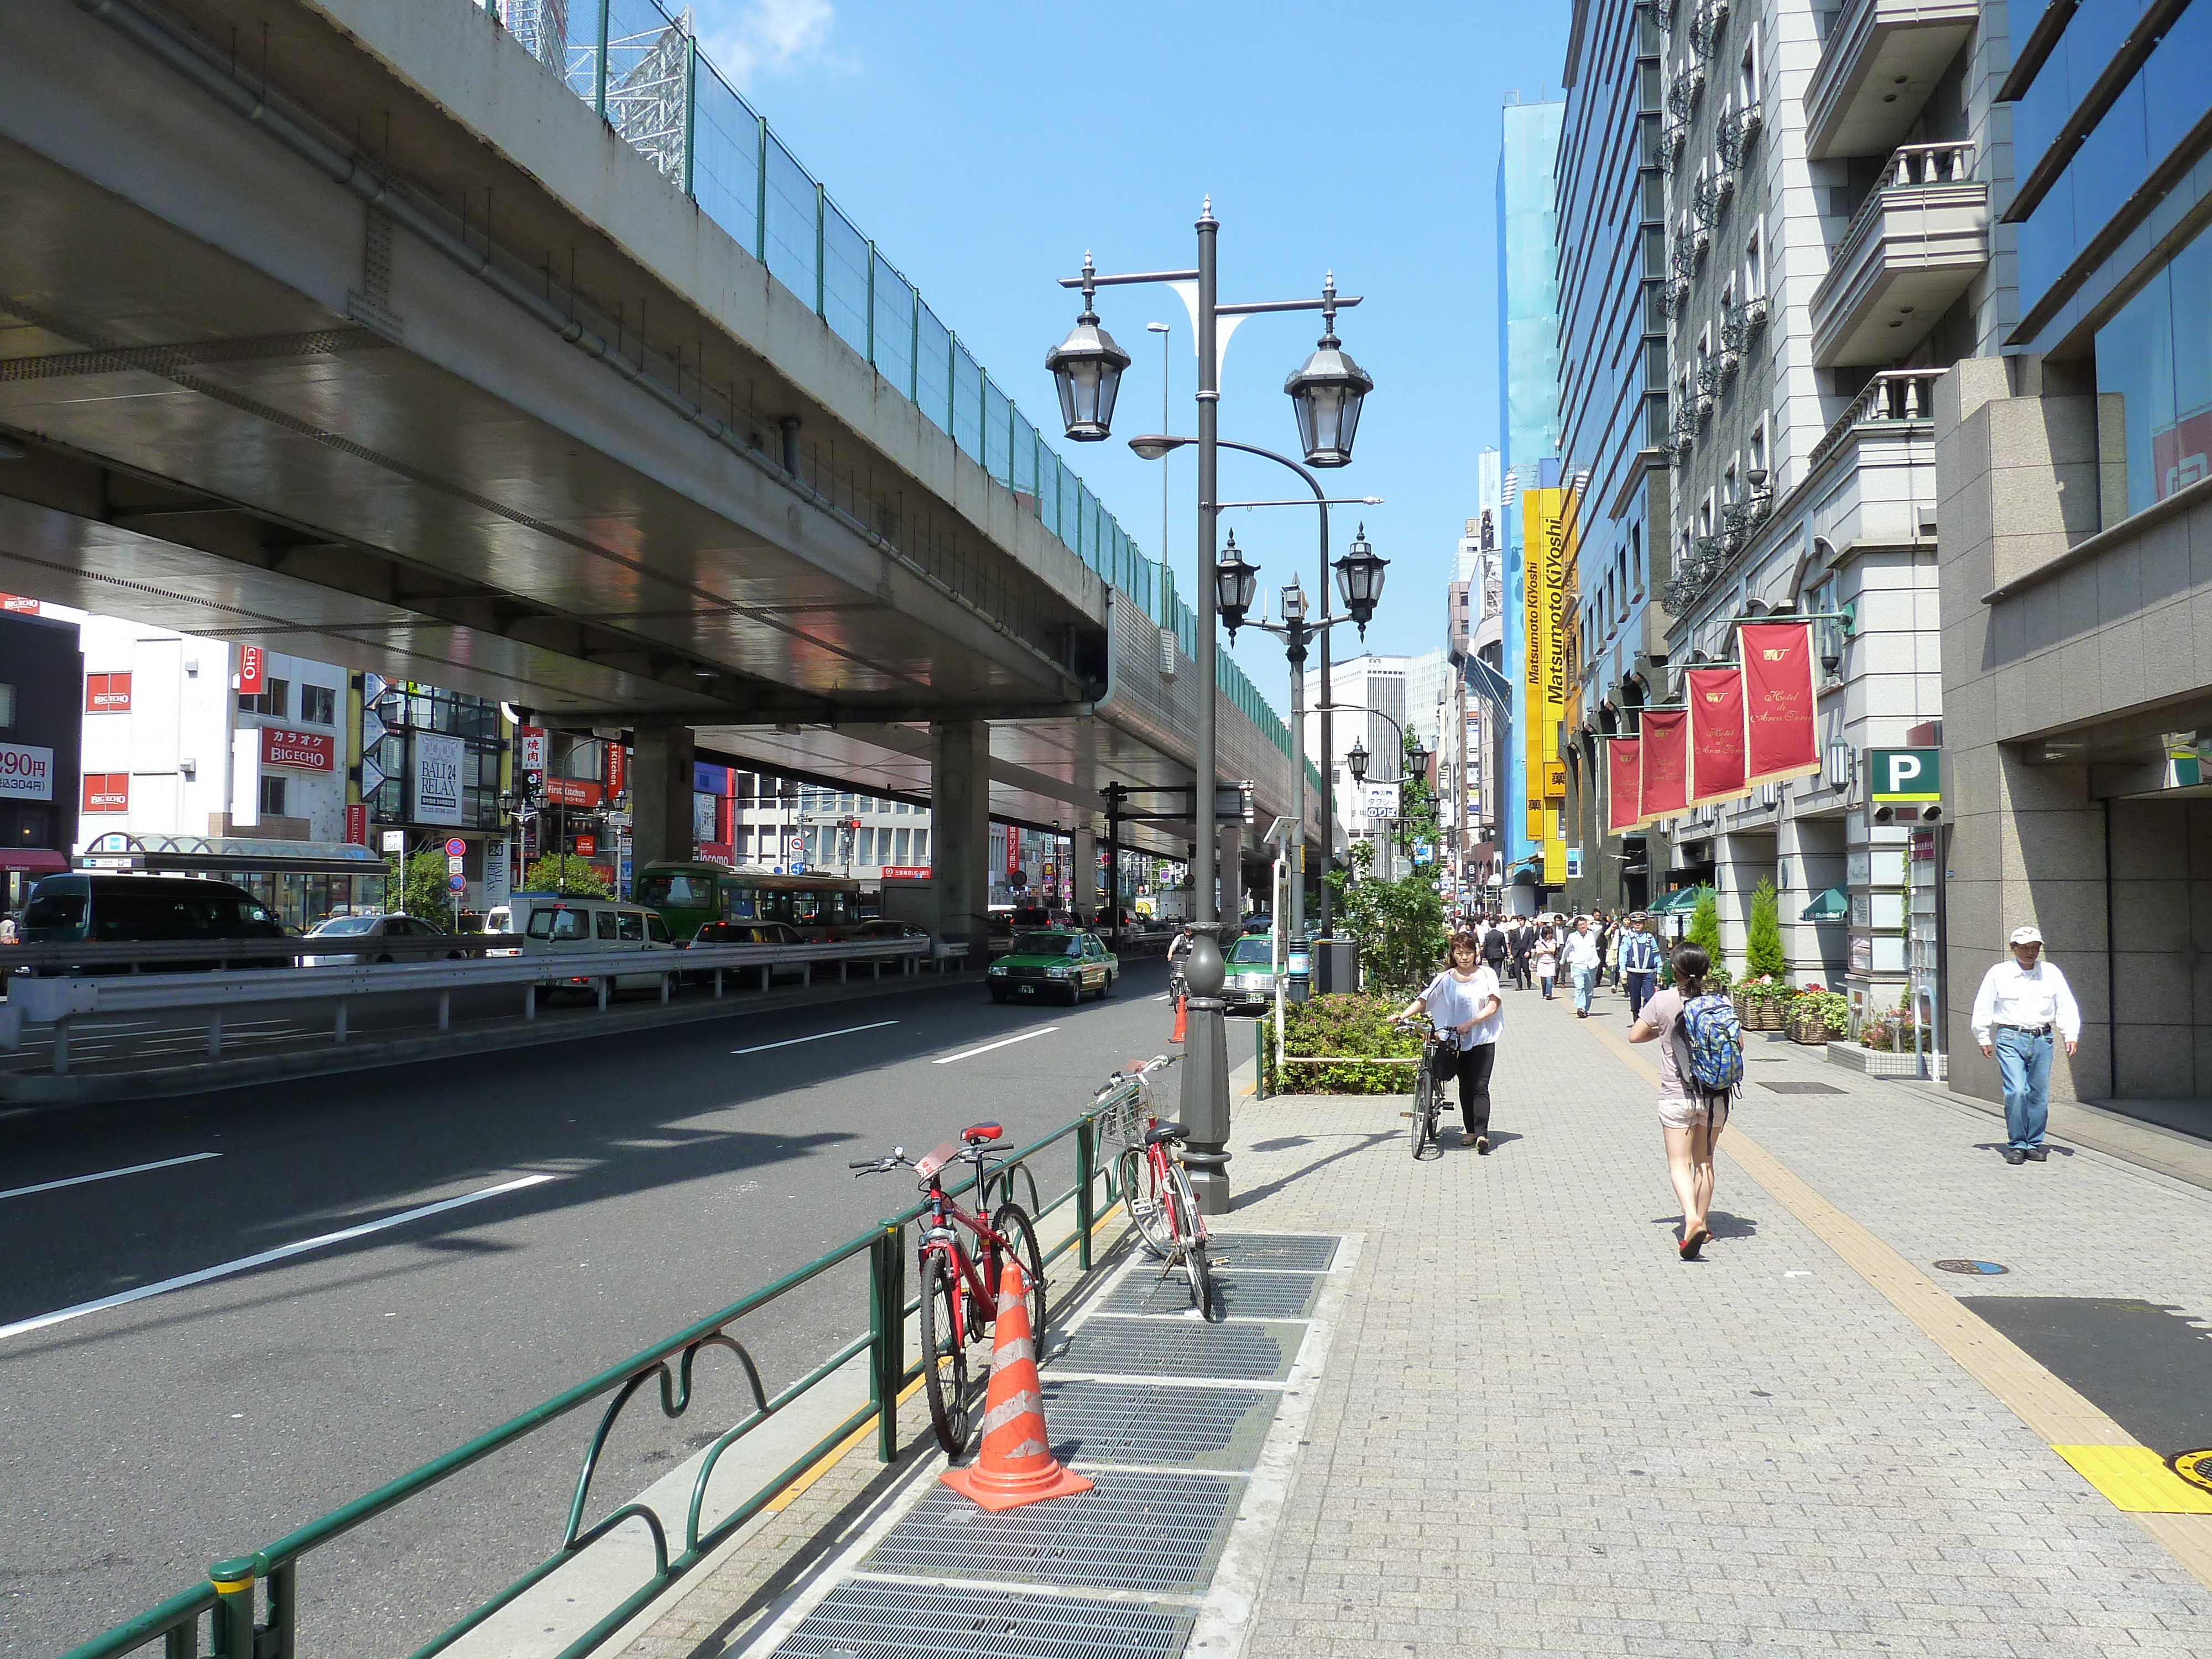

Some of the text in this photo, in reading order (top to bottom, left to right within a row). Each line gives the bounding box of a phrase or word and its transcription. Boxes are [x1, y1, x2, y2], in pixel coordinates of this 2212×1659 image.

[1528, 611, 1539, 685] Matsumoto
[1547, 589, 1563, 705] Matsumoto
[94, 695, 128, 704] BIG ECHO
[1764, 690, 1799, 701] Hotel
[1776, 701, 1786, 711] di
[1706, 727, 1735, 737] Hotel
[273, 731, 324, 747] カラオケ
[271, 747, 325, 766] BIG ECHO
[526, 739, 540, 762] 焼肉
[0, 752, 46, 778] 90円
[421, 760, 456, 780] BALI 24
[1551, 771, 1565, 785] 薬
[1888, 754, 1921, 792] P
[0, 779, 45, 791] 込304円)
[421, 777, 456, 796] RELAX
[548, 785, 562, 795] First
[91, 795, 126, 804] BIG ECHO
[1528, 799, 1542, 811] 薬
[1368, 807, 1397, 817] のりば
[490, 846, 502, 854] 24
